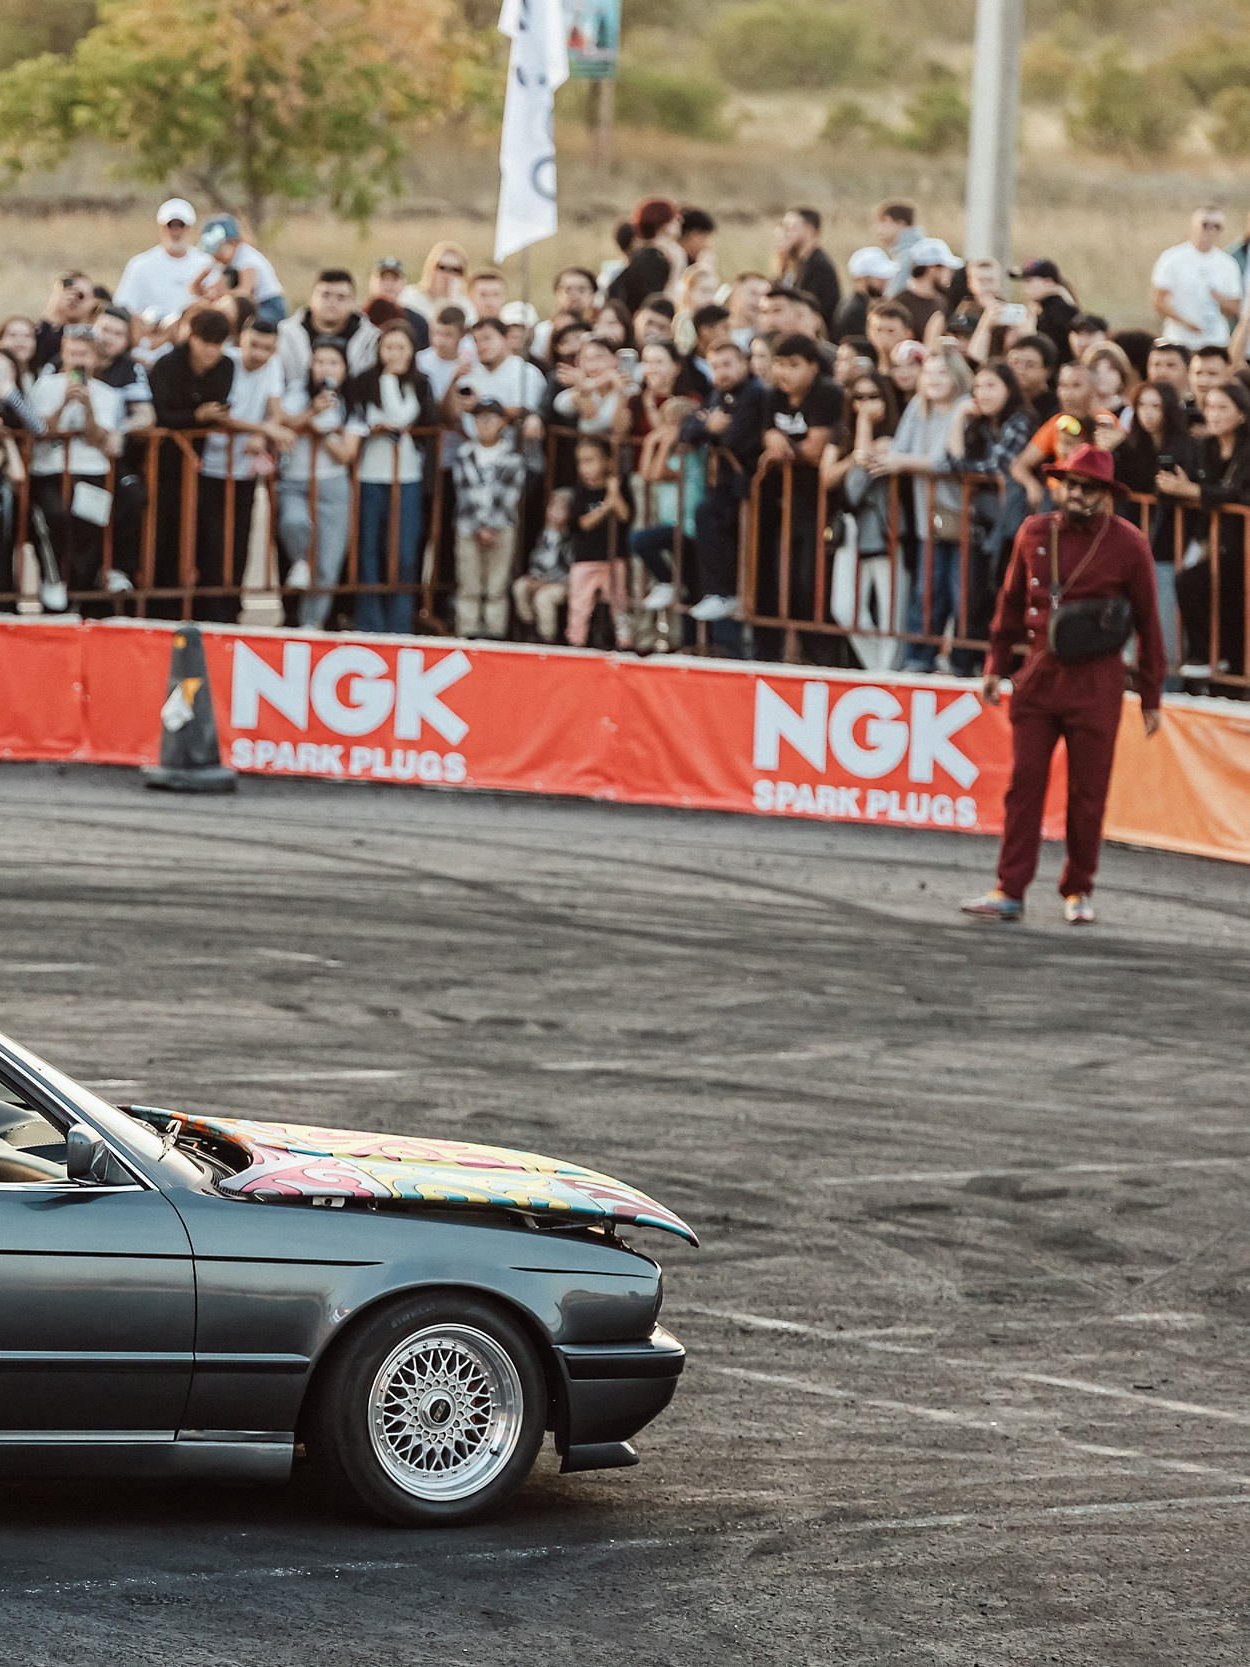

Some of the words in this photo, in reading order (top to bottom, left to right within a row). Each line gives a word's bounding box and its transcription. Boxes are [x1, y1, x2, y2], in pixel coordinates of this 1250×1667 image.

[231, 639, 473, 746] NGK
[231, 738, 344, 775] SPARK
[350, 746, 467, 783] PLUGS
[753, 678, 982, 790] NGK
[753, 779, 861, 818] SPARK
[866, 788, 977, 828] PLUGS
